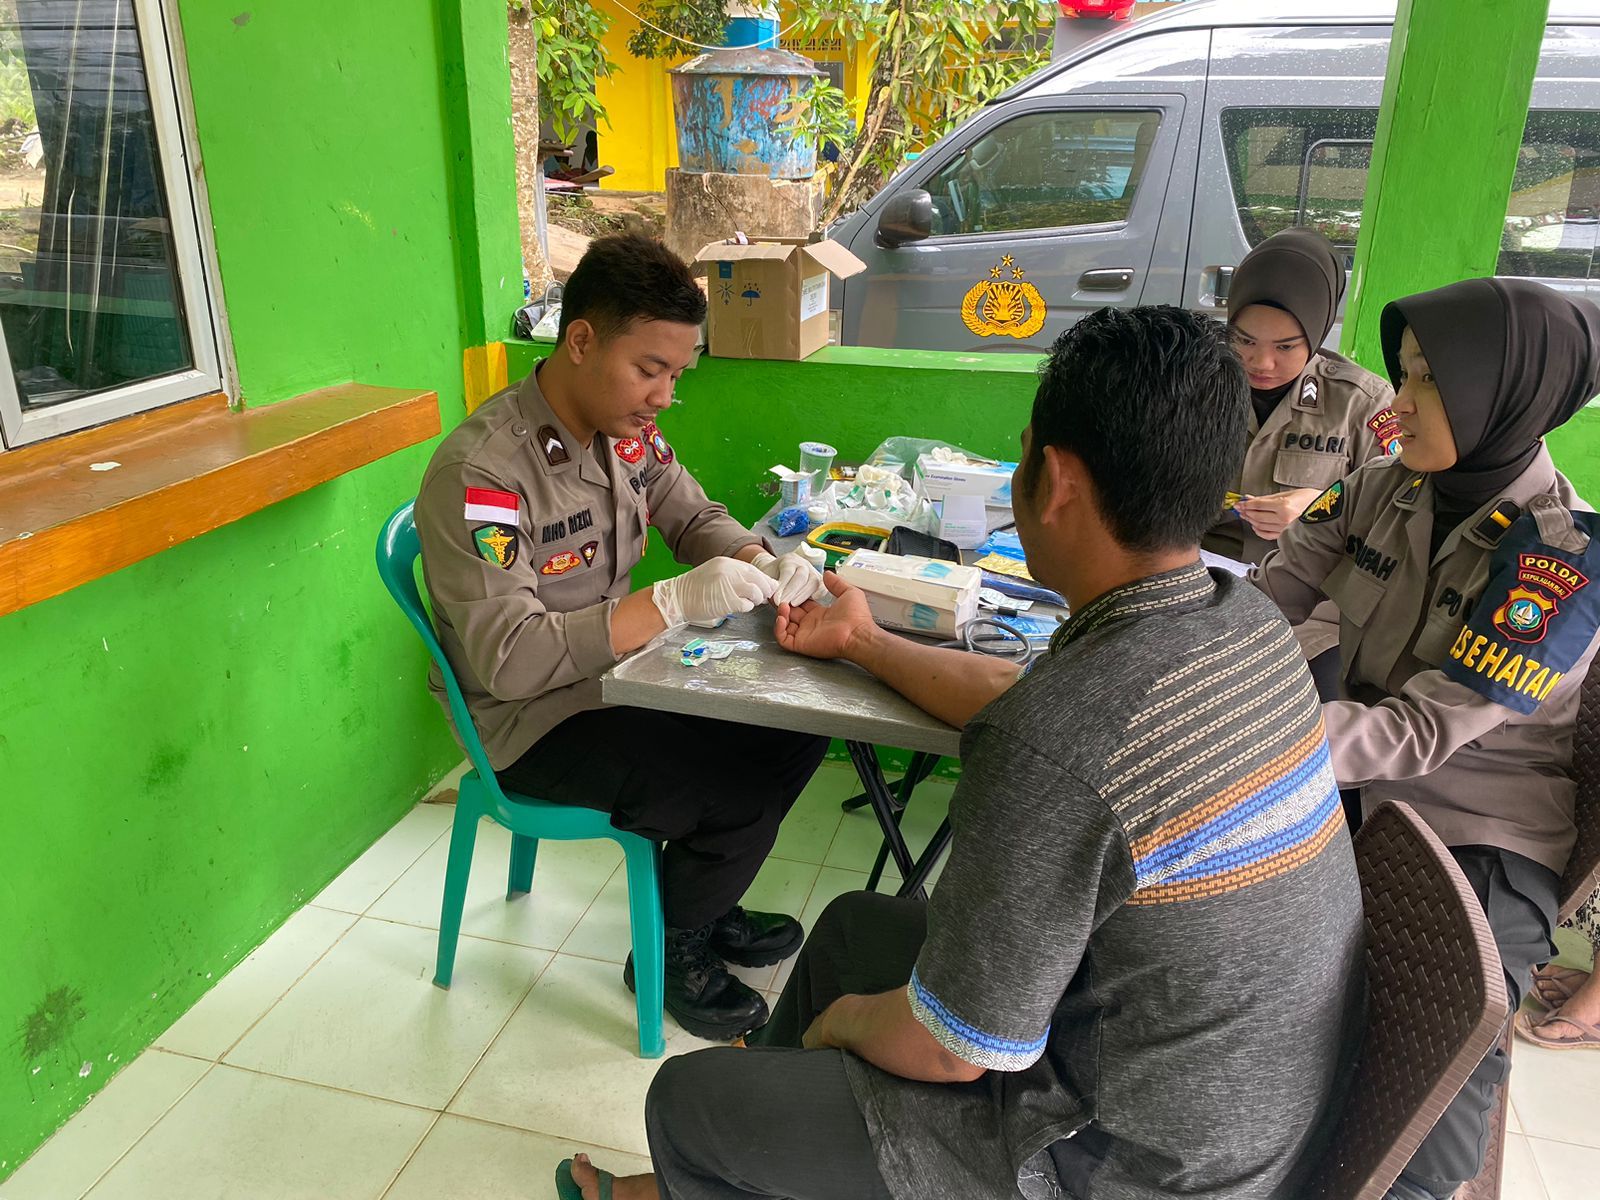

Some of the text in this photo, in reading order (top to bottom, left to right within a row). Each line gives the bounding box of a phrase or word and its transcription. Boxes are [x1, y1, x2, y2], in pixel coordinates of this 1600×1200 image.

[1285, 432, 1345, 453] POLRI
[1525, 557, 1578, 586] POLDA
[1522, 572, 1567, 596] KEPULAUAN RIAU
